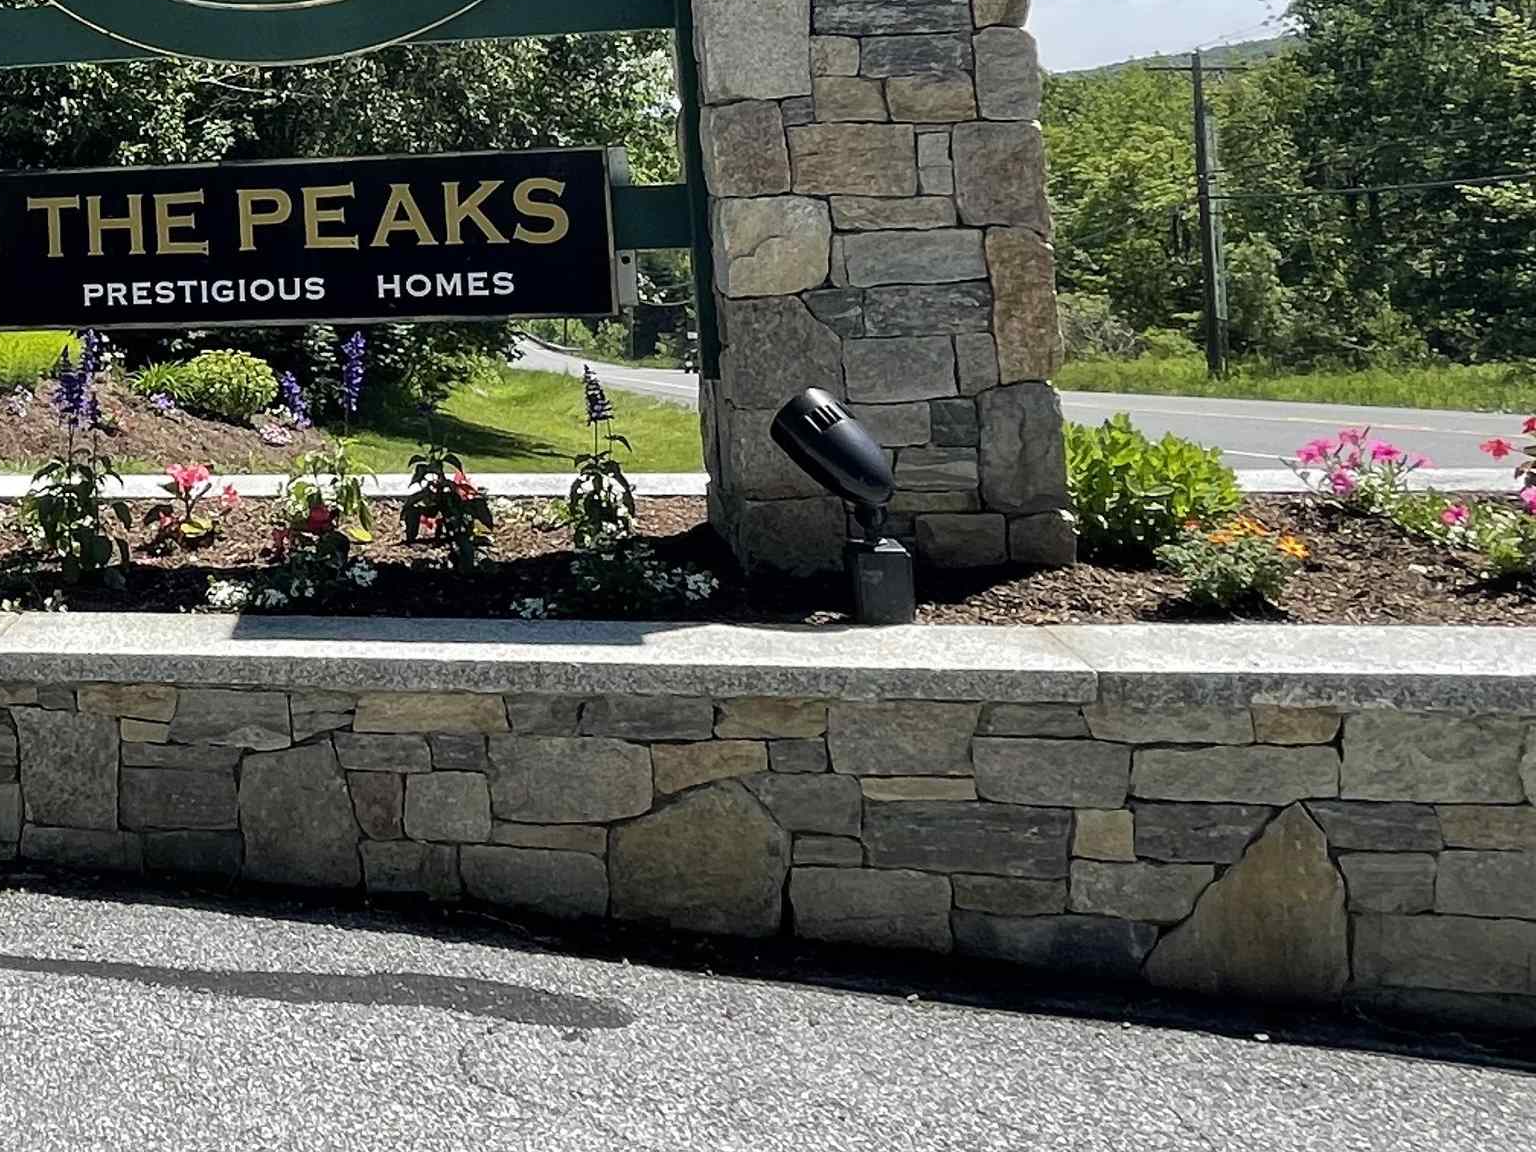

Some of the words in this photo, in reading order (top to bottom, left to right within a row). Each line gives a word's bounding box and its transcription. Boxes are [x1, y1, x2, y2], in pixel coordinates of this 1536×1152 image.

[27, 189, 209, 257] THE
[236, 178, 569, 250] PEAKS
[82, 278, 325, 307] PRESTIGIOUS
[376, 272, 515, 299] HOMES
